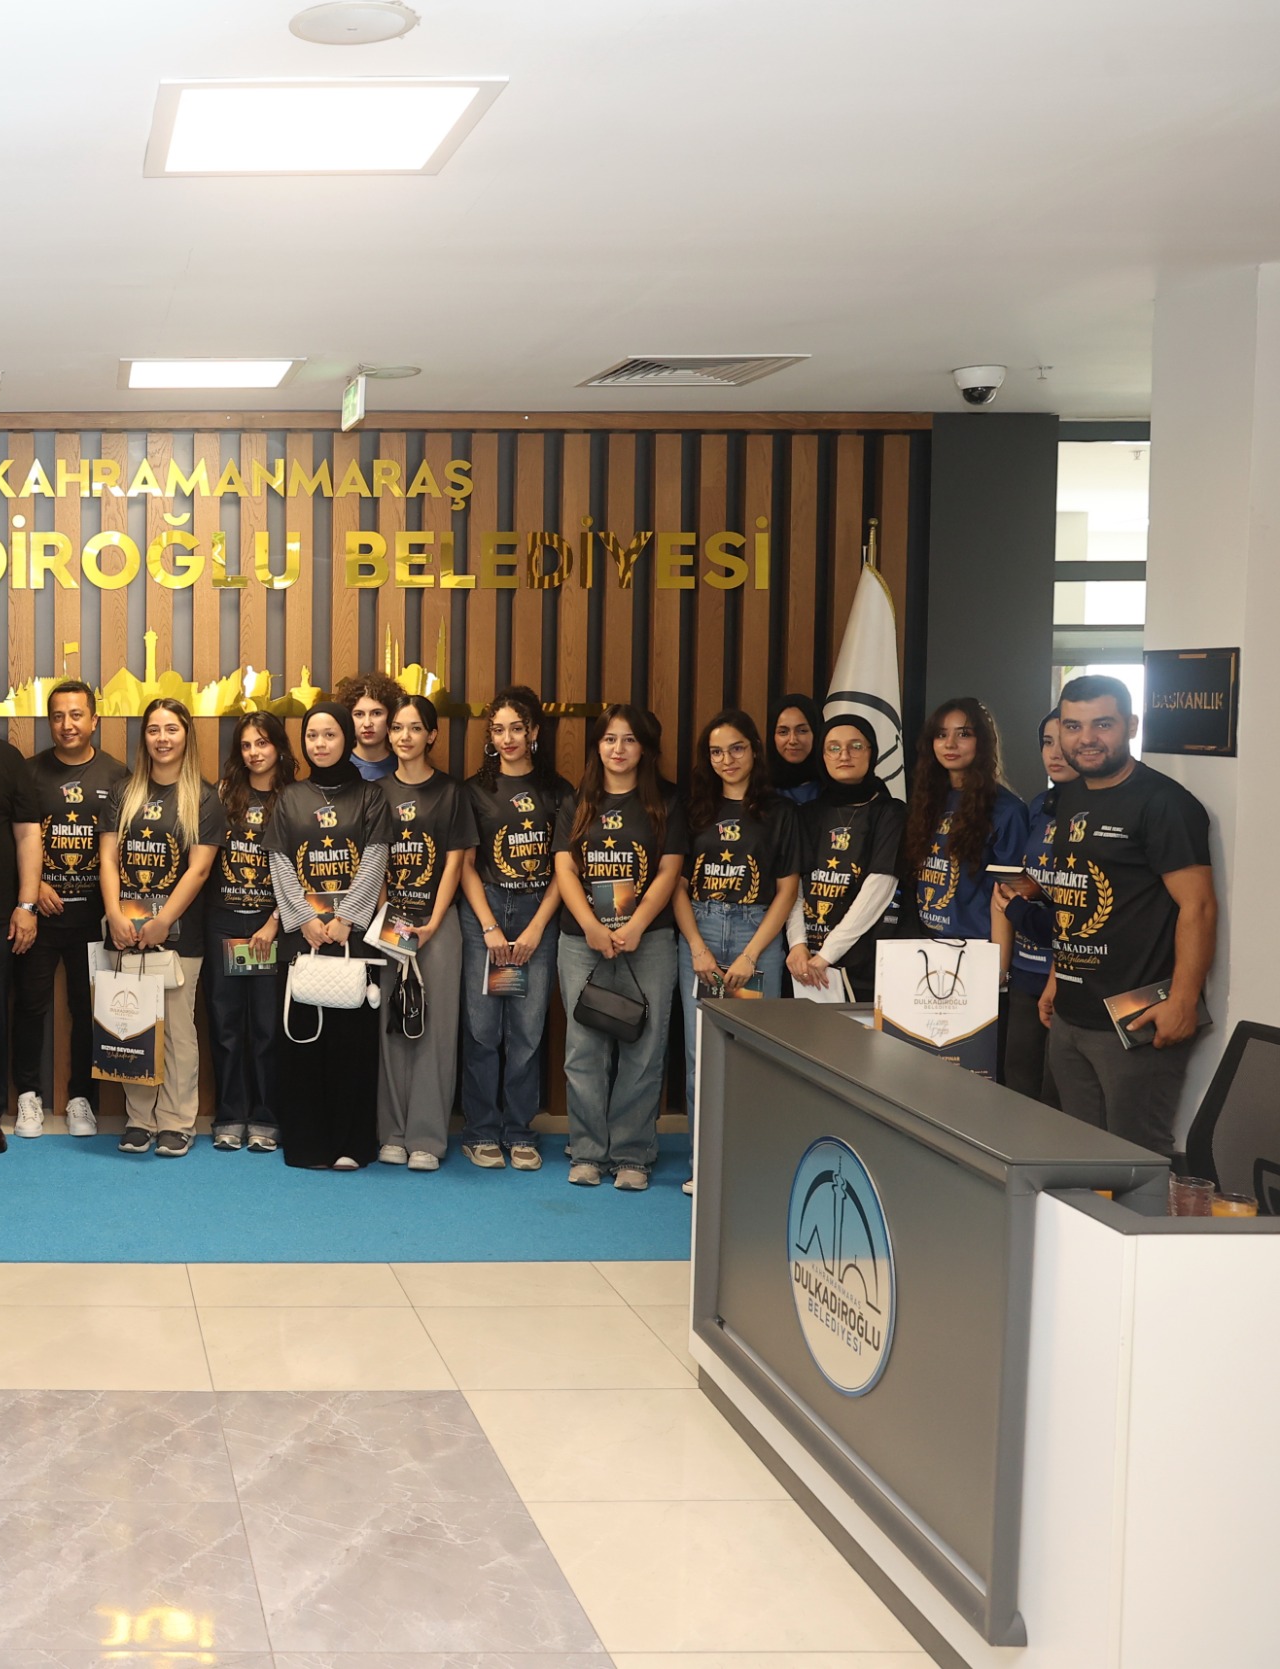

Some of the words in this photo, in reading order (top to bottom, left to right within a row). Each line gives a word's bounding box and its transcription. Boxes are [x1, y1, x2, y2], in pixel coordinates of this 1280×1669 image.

[345, 515, 769, 590] BELEDİYESİ
[52, 824, 94, 836] BİRLİKTE
[51, 836, 94, 850] ZİRVEYE
[508, 831, 546, 845] BİRLİKT
[127, 839, 167, 854] BİRLİKTE
[230, 839, 261, 854] BİRLİK
[127, 852, 166, 867] ZİRVEYE
[309, 848, 349, 862] BİRLİKTE
[587, 850, 633, 863] BİRLİKTE
[309, 861, 350, 877] ZİRVEYE
[587, 862, 633, 877] ZİRVEYE
[397, 890, 431, 899] AKADEMİ
[1062, 942, 1108, 955] AKADEMİ
[794, 1261, 880, 1351] DULKADİROĞLU
[808, 1298, 862, 1355] BELEDİYESİ
